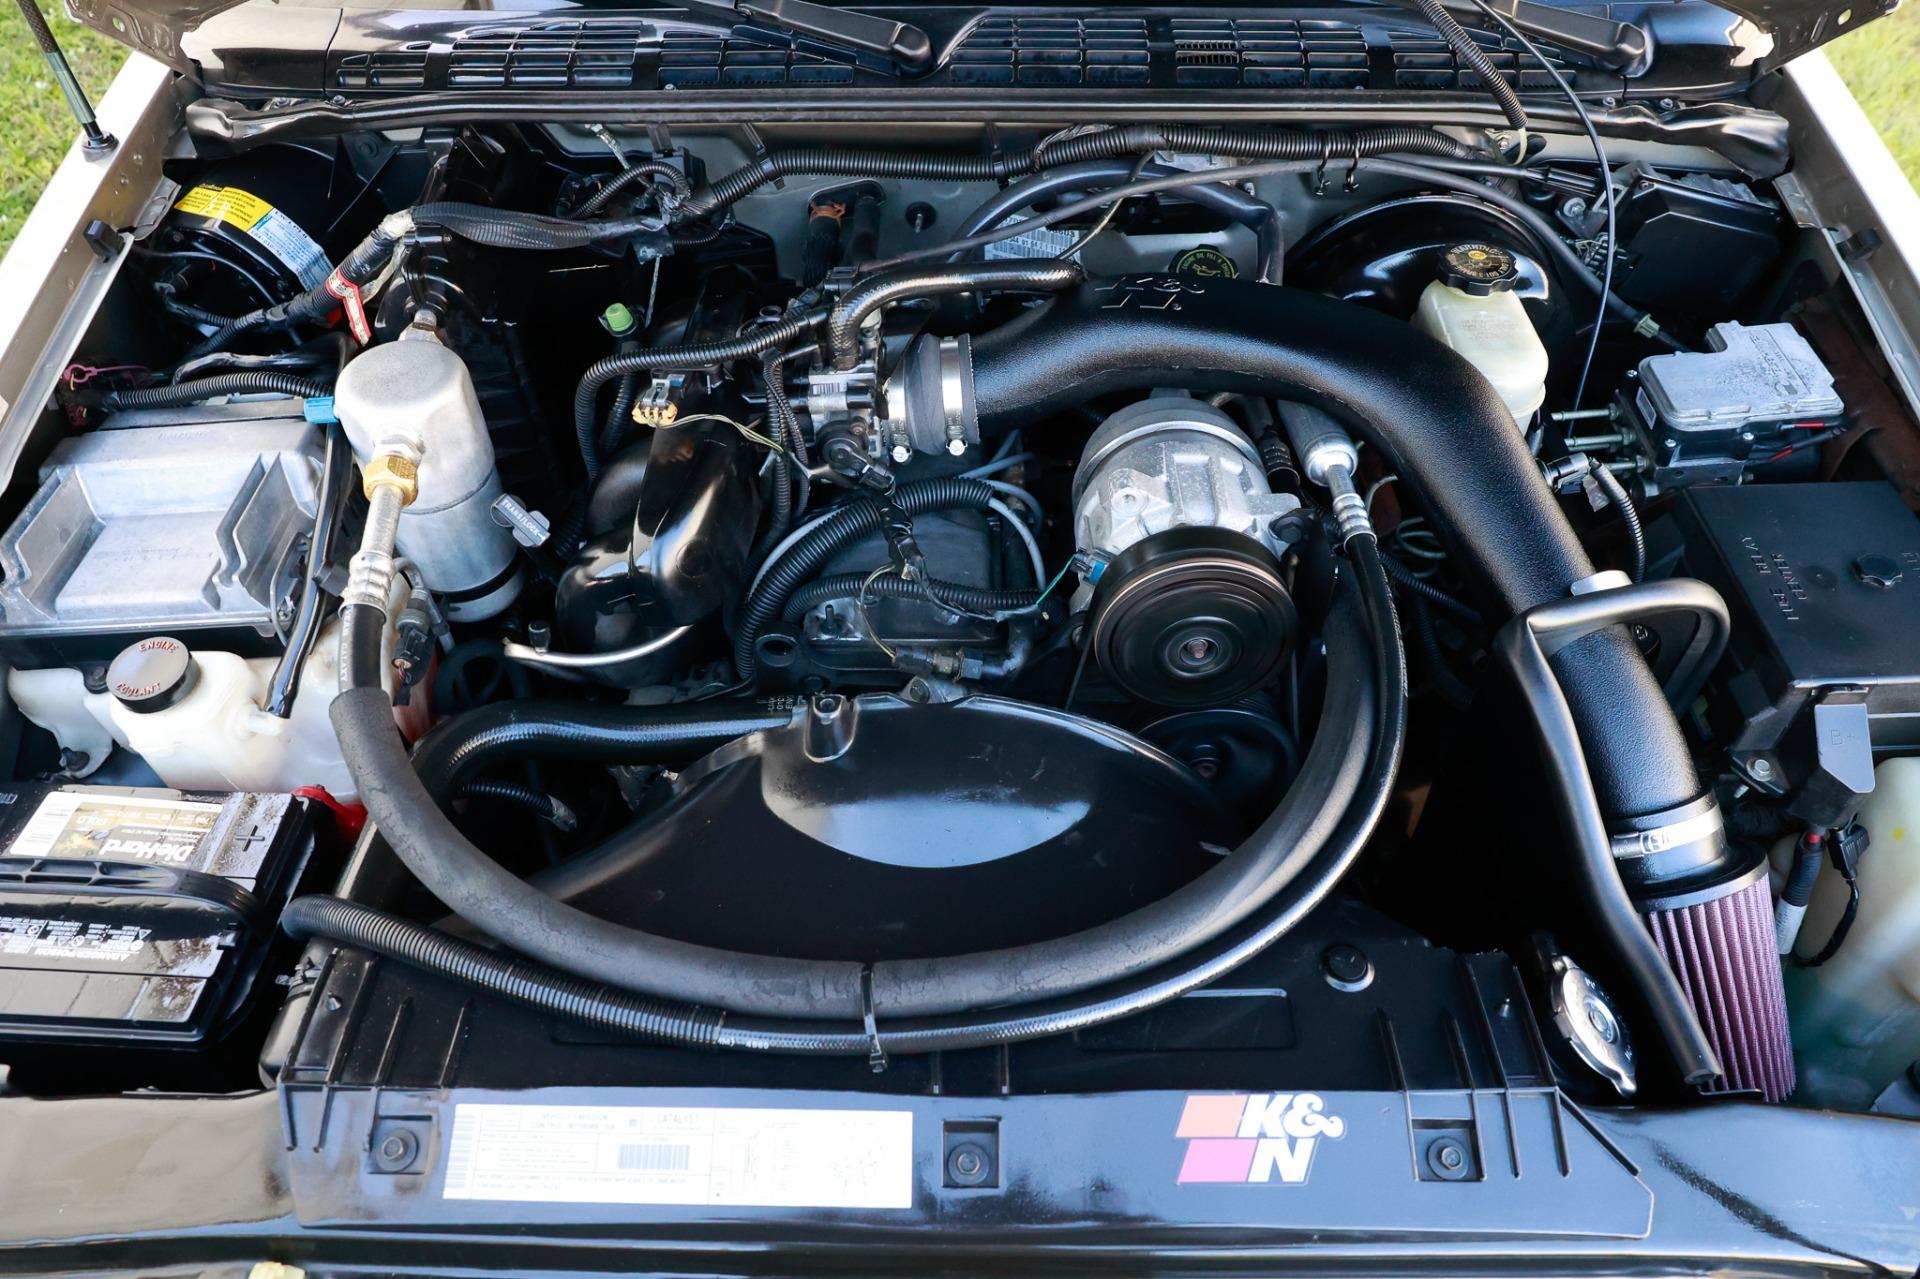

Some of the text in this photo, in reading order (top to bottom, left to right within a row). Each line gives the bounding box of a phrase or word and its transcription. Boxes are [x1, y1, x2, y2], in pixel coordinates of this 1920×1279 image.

[139, 640, 178, 653] ENGINE
[116, 682, 161, 698] COOLANT
[99, 839, 195, 862] DieHard
